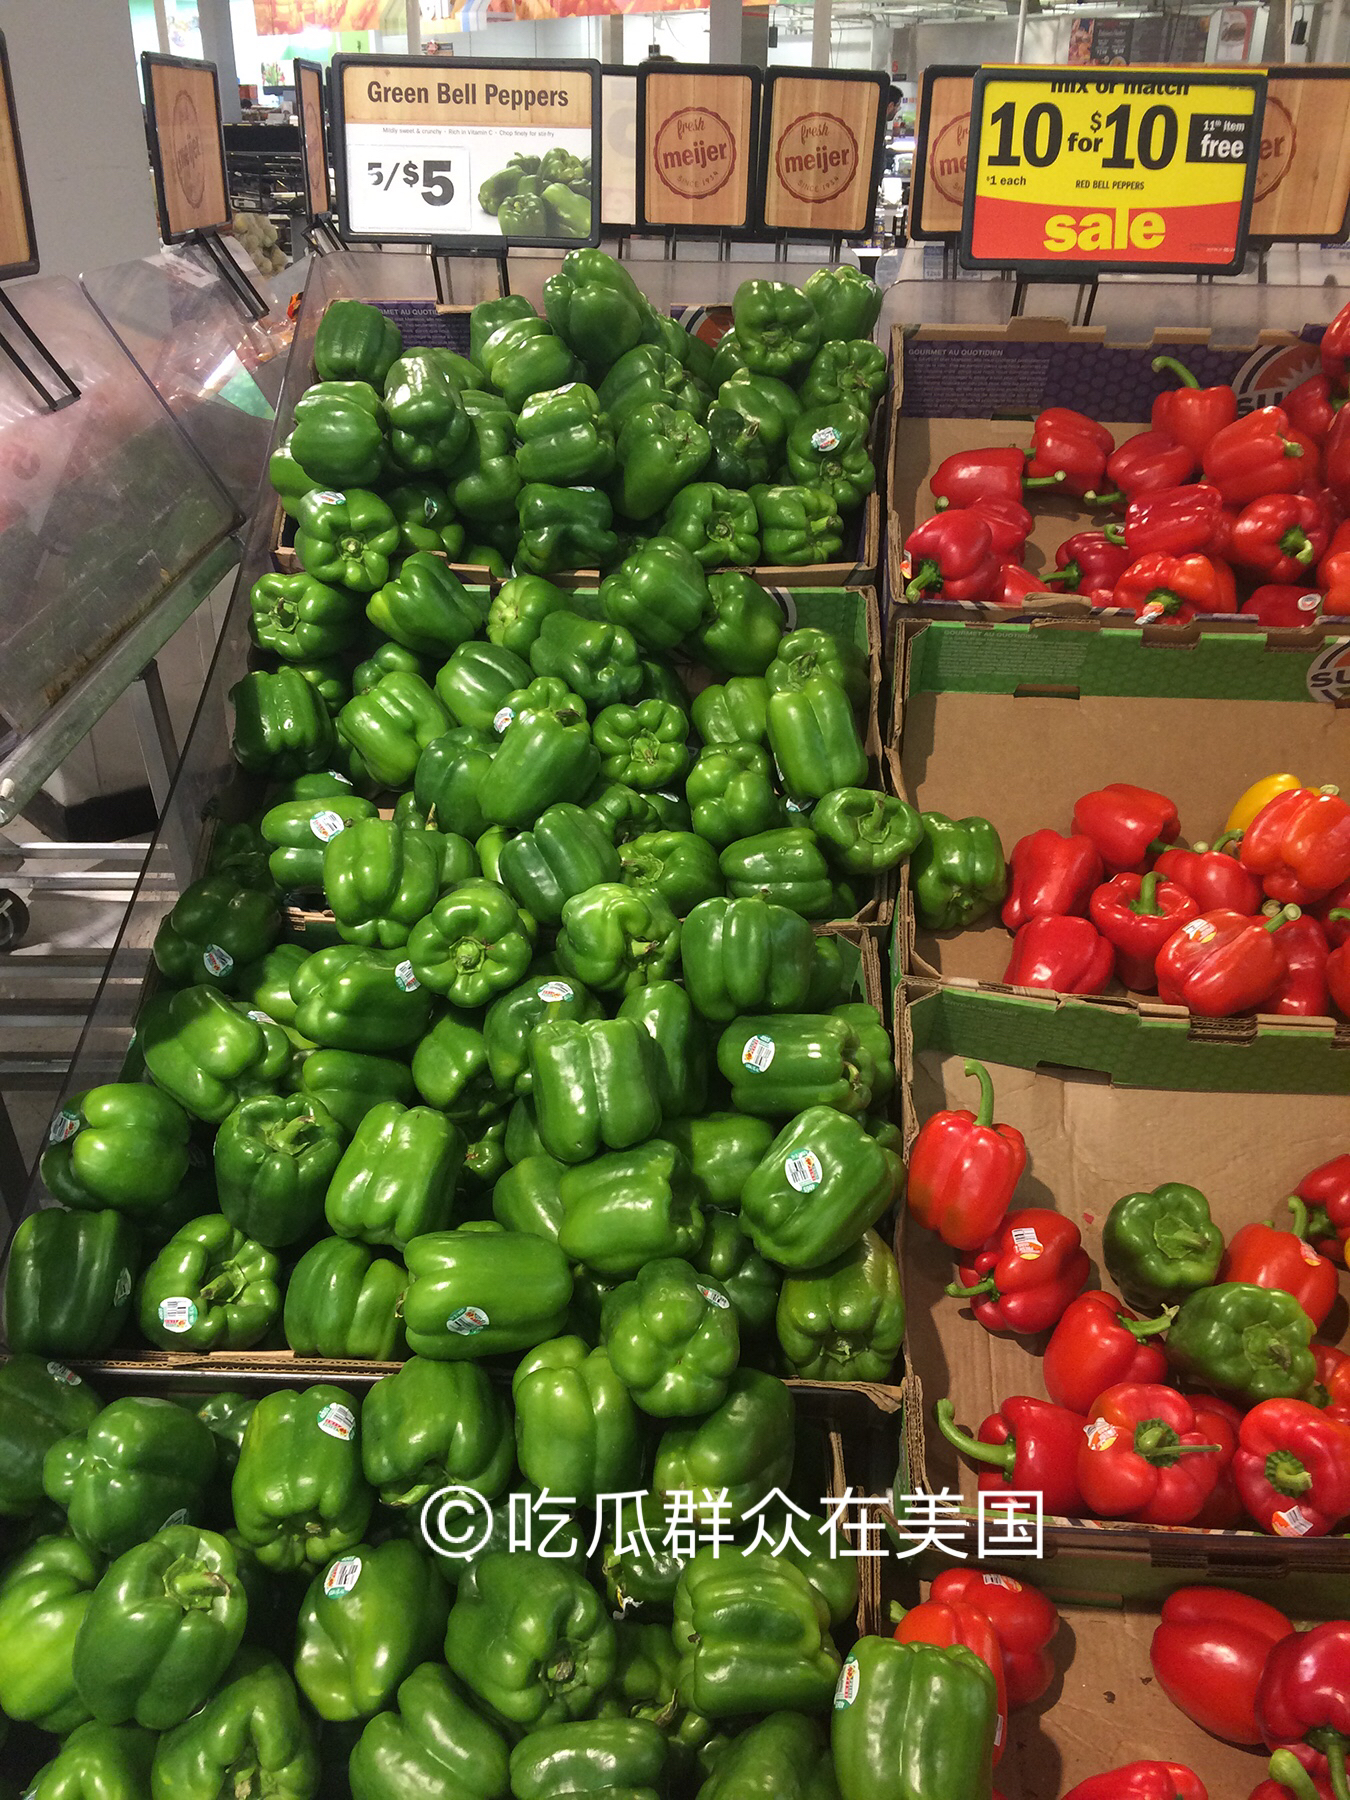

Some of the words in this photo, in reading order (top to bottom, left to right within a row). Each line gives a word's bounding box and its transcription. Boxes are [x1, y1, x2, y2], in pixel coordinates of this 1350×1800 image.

[367, 80, 429, 104] Green
[437, 82, 477, 105] Bell
[485, 84, 569, 111] Peppers
[421, 128, 442, 136] crunchy
[676, 117, 706, 140] fresh
[800, 122, 830, 146] fresh
[987, 101, 1064, 168] 10
[1067, 132, 1103, 153] for
[1222, 119, 1245, 132] item
[662, 140, 728, 169] meijer
[1200, 133, 1244, 159] free
[784, 145, 850, 174] meijer
[676, 174, 700, 188] SINCE
[797, 179, 820, 192] SINCE
[1000, 175, 1027, 187] each
[1075, 179, 1091, 189] RED
[1092, 180, 1110, 190] BELL
[1112, 180, 1145, 191] PEPPERS
[1043, 207, 1167, 253] sale
[908, 348, 948, 356] GOURMET
[949, 348, 960, 356] AU
[960, 349, 1004, 357] QUOTIDIEN
[943, 629, 982, 638] GOURMET
[983, 631, 995, 639] AU
